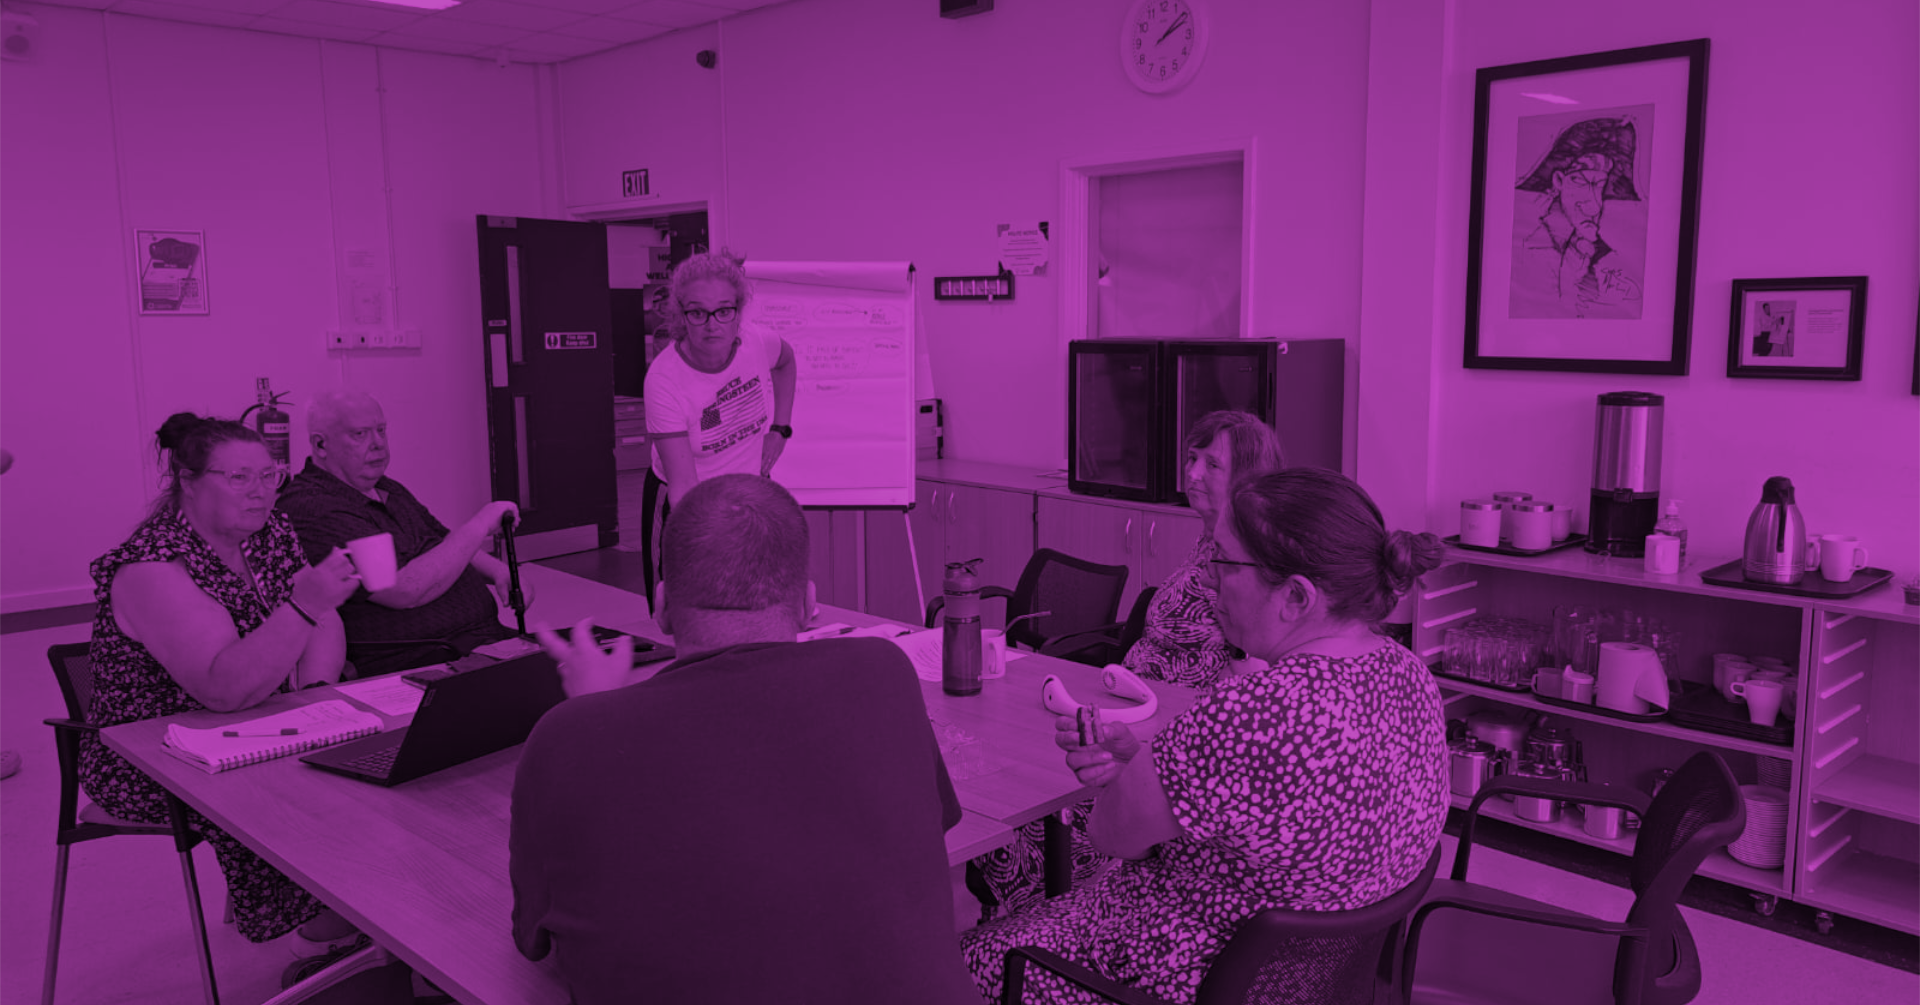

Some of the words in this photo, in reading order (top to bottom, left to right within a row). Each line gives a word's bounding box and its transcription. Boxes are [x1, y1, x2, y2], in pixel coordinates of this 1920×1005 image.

[1159, 0, 1169, 12] 12
[1174, 3, 1178, 14] 1
[1147, 8, 1155, 19] 11
[1139, 22, 1148, 33] 10
[1185, 28, 1191, 40] 3
[1136, 38, 1142, 50] 9
[1181, 46, 1187, 56] 4
[1139, 54, 1145, 65] 8
[1172, 59, 1178, 70] 5
[1148, 63, 1154, 73] 7
[1160, 65, 1166, 77] 6
[624, 171, 647, 197] EXIT
